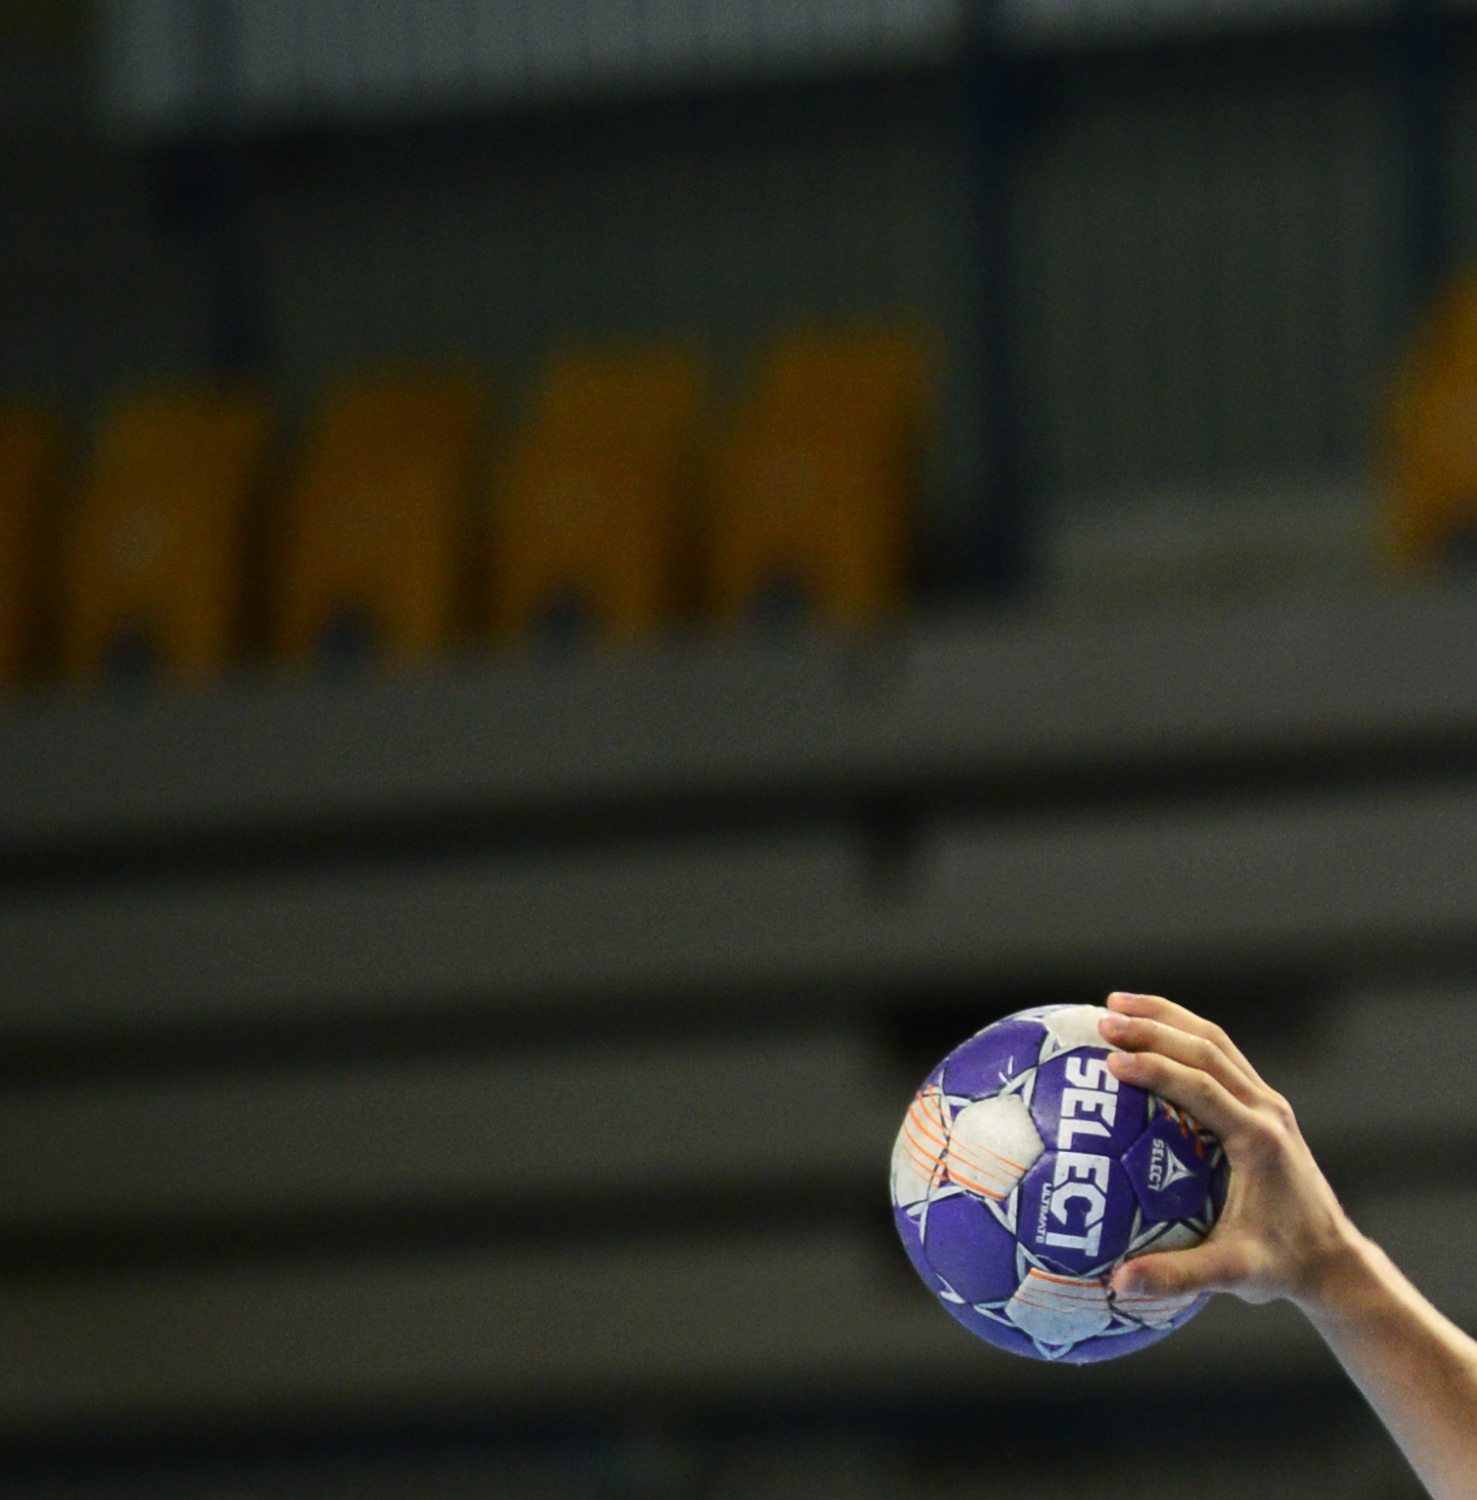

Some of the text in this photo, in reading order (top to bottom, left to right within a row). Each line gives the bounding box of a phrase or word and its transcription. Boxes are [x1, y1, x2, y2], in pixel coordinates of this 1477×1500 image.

[1045, 1056, 1120, 1257] SELECT
[1148, 1138, 1164, 1191] SELECT
[1035, 1182, 1053, 1244] ULTIMATE
